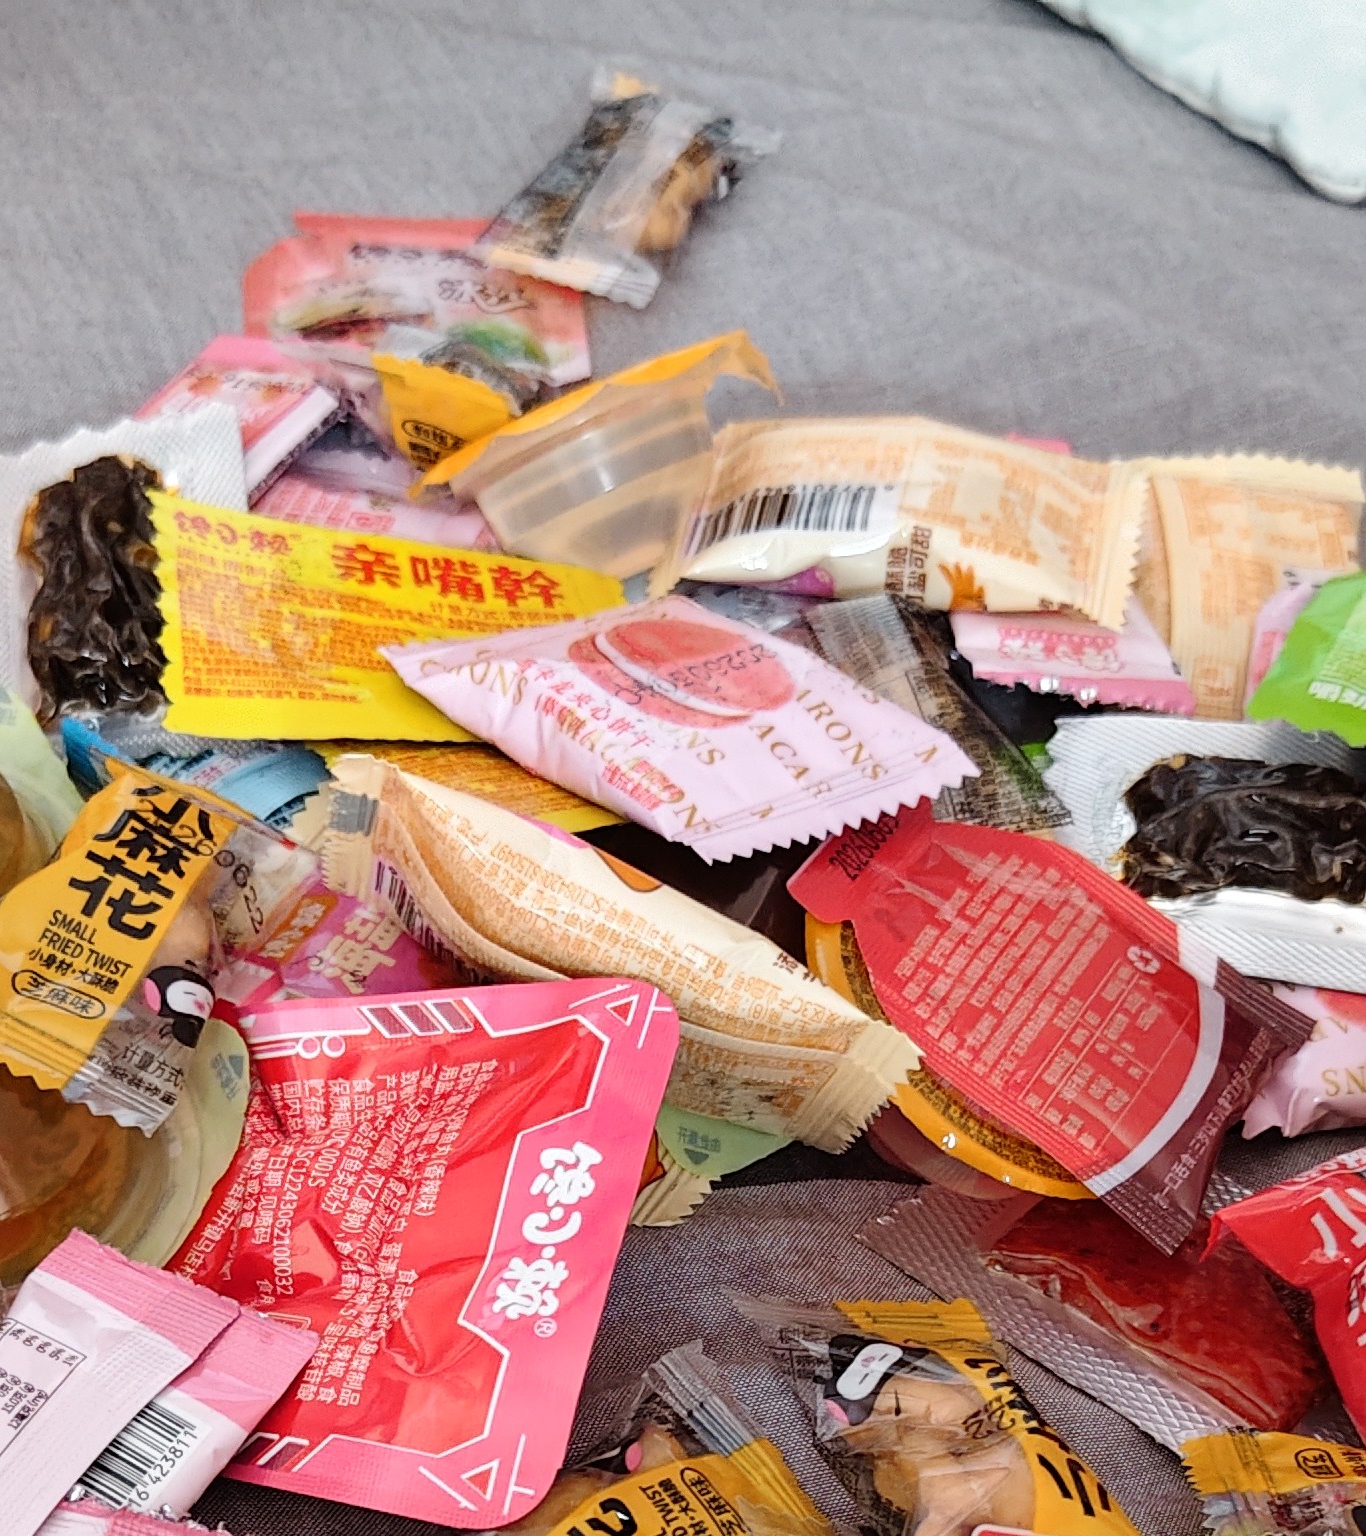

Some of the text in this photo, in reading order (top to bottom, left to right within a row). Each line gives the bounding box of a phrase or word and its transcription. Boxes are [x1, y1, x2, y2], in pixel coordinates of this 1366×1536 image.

[69, 785, 213, 939] 小麻花
[49, 910, 98, 946] SMALL
[38, 928, 133, 979] FRIED TWIST
[22, 976, 98, 1017] 芝麻味
[145, 1428, 197, 1488] 423811
[640, 1484, 681, 1528] TWIST
